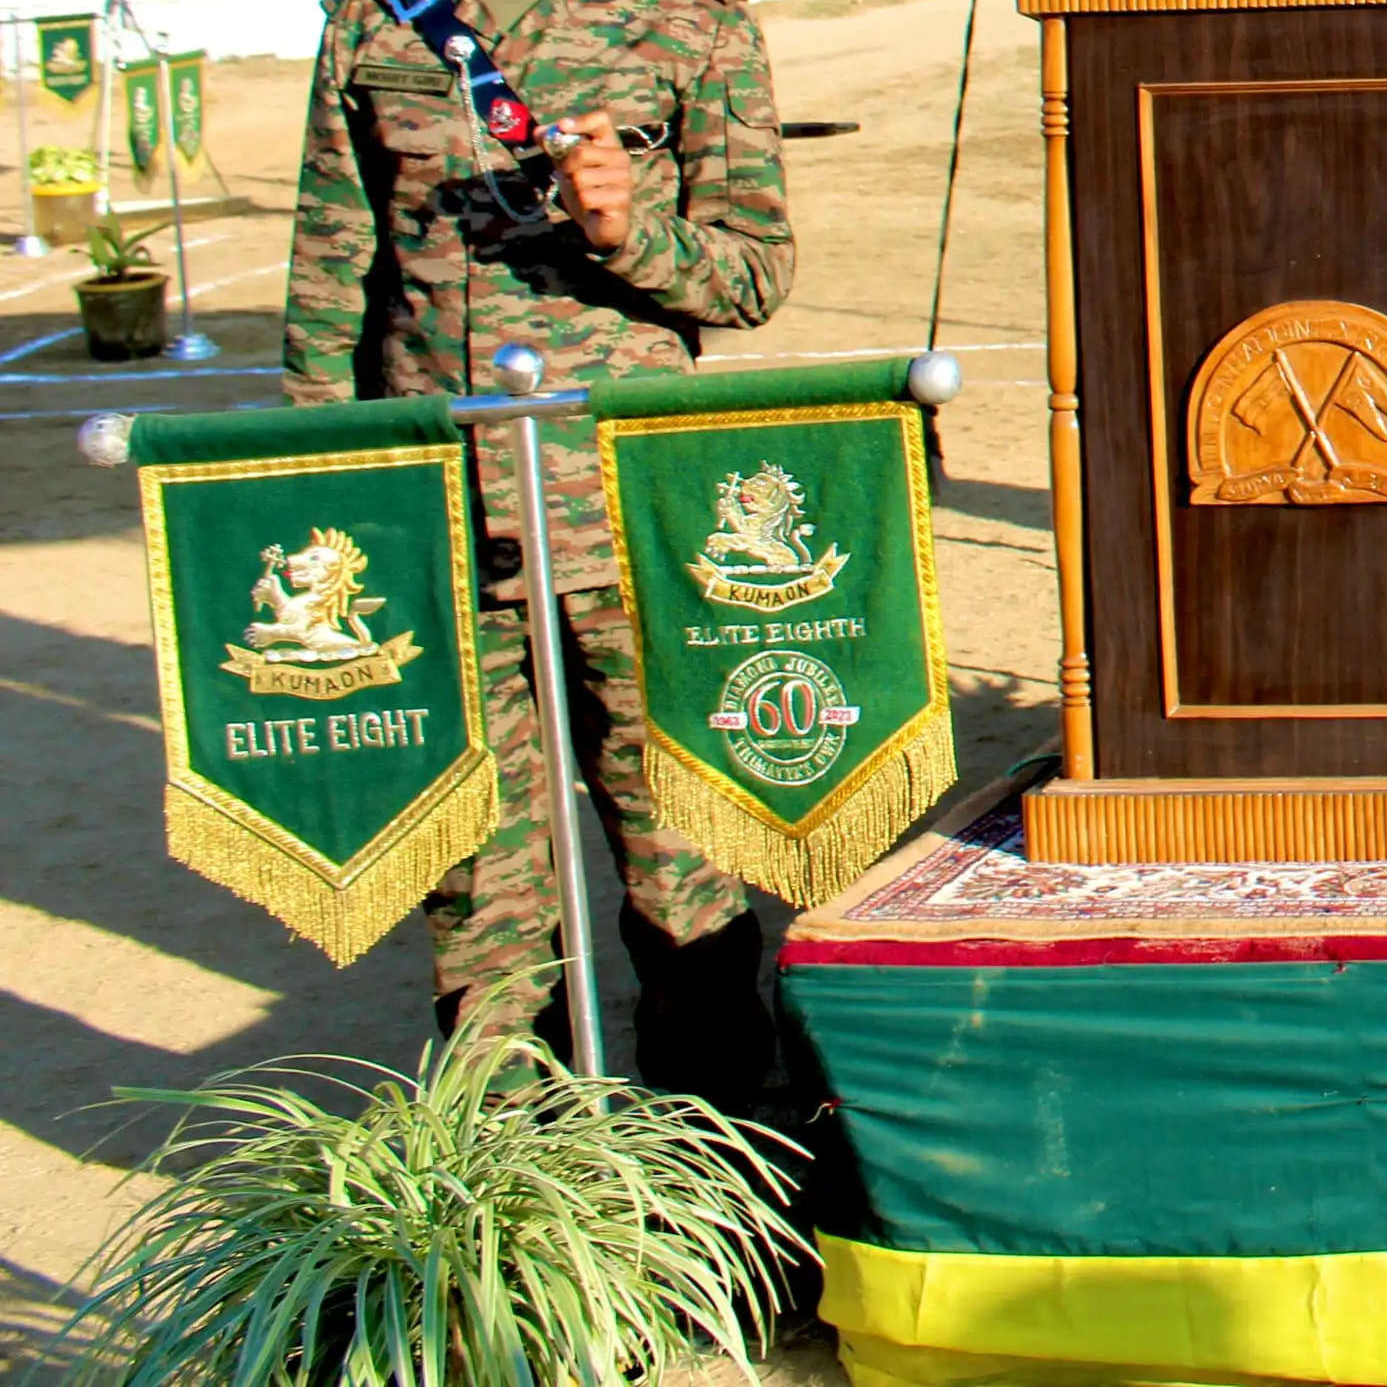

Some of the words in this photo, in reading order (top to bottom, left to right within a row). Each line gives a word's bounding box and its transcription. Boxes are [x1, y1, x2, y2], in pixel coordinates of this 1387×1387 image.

[729, 582, 811, 607] KUMAON
[684, 624, 760, 646] ELITE
[764, 617, 867, 644] EIGHTH
[270, 663, 374, 695] KUMAON
[748, 679, 816, 736] 60
[225, 717, 321, 761] ELITE
[327, 708, 429, 753] EIGHT
